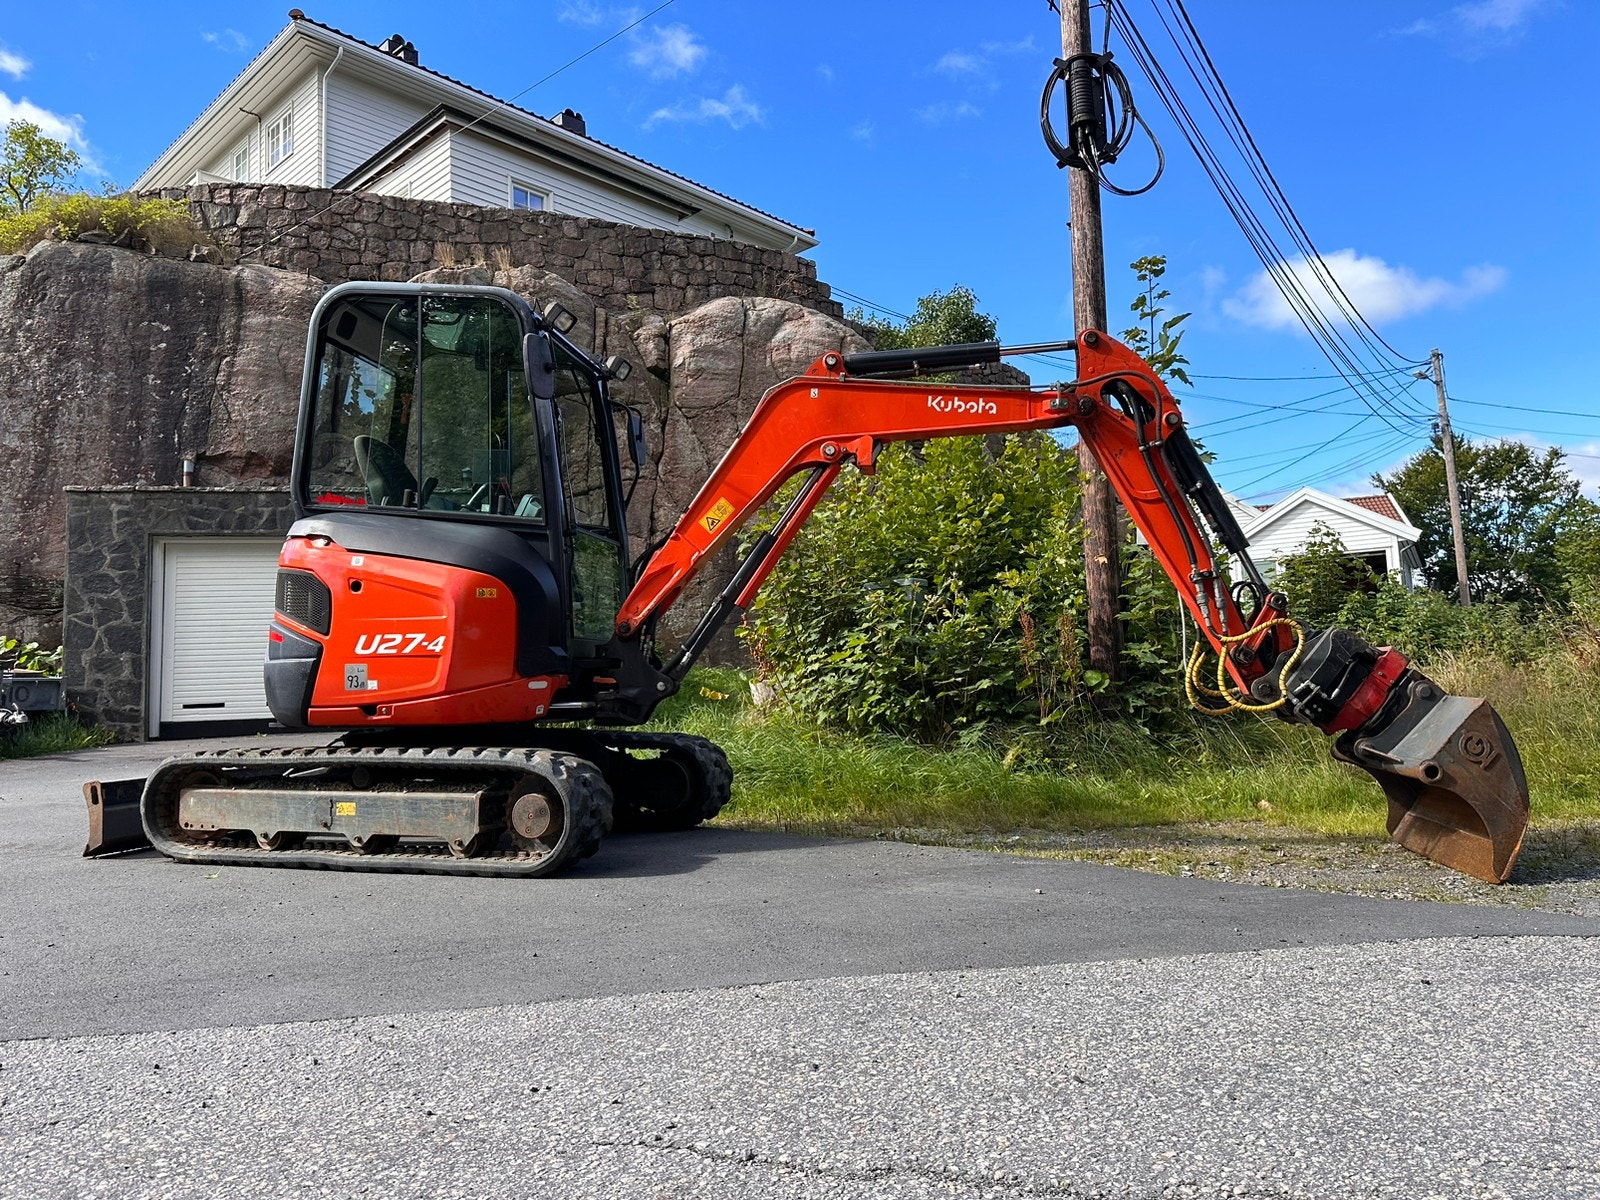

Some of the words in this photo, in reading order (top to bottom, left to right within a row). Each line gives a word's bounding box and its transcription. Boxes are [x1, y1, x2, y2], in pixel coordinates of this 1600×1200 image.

[927, 395, 997, 415] Kubota
[354, 633, 446, 655] U27-4
[347, 675, 359, 688] 93
